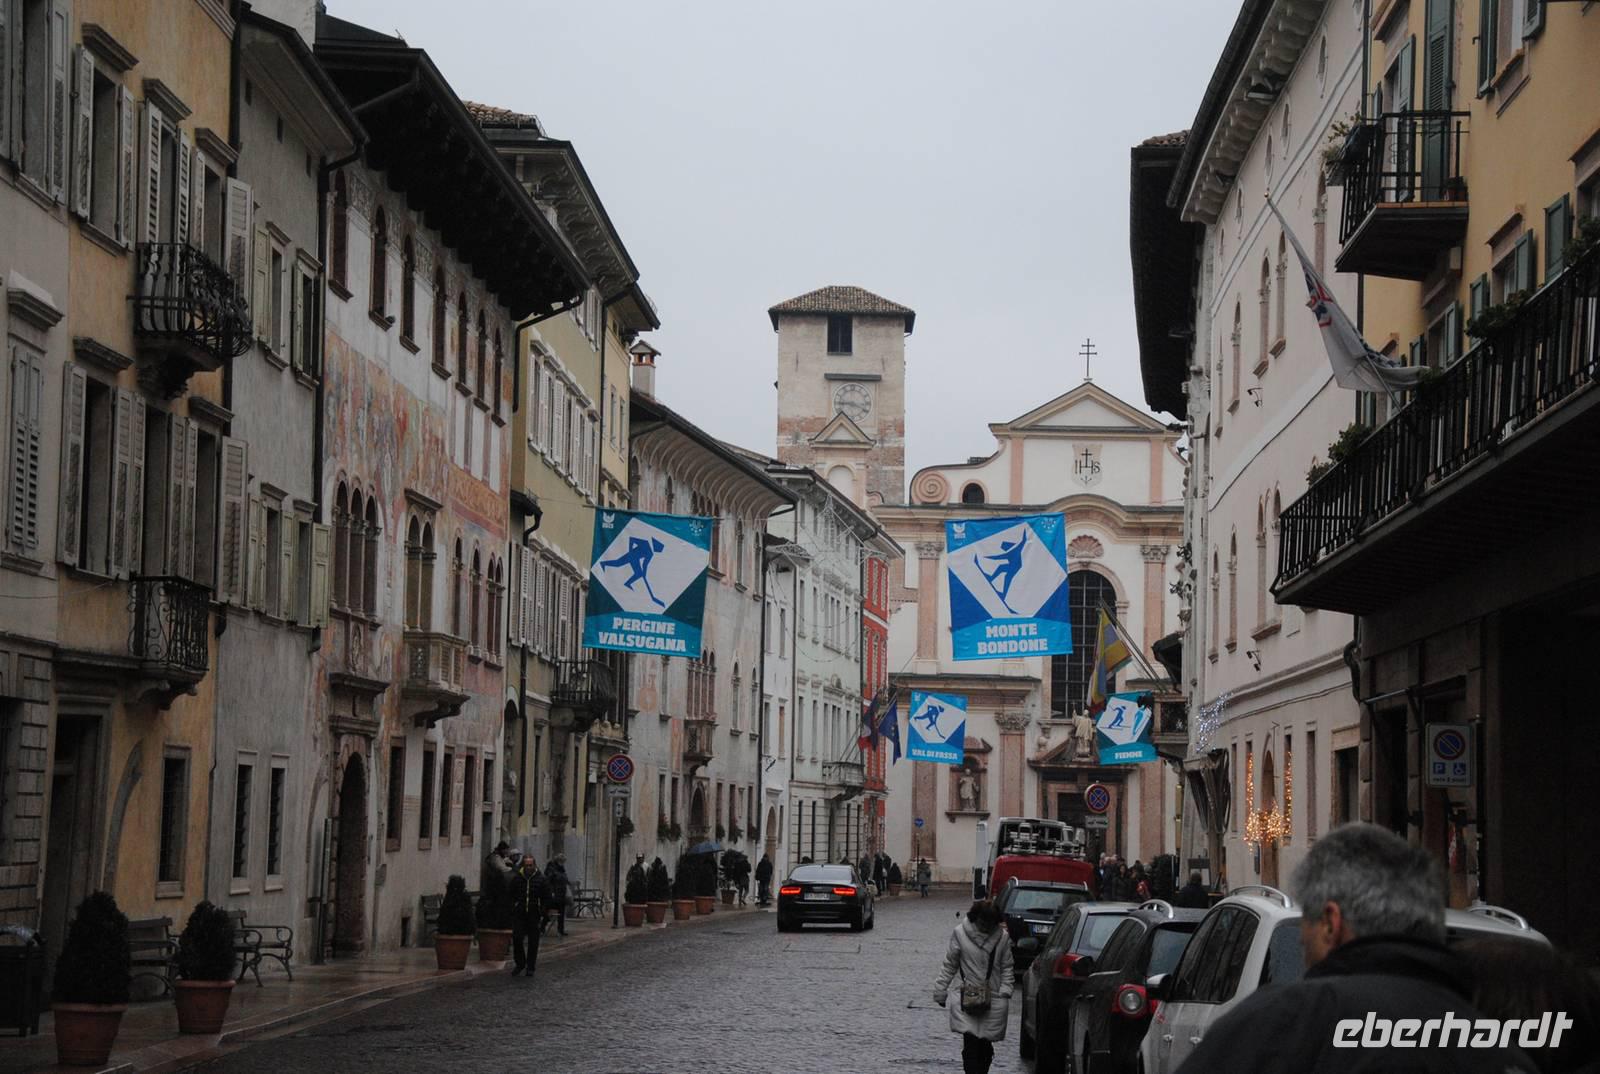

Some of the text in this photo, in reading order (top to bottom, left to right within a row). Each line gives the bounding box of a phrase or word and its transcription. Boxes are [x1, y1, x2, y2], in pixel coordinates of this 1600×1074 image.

[612, 617, 676, 635] PERGINE
[985, 623, 1038, 639] MONTE
[598, 632, 686, 652] VALSUGANA
[977, 638, 1048, 655] BONDONE
[1115, 751, 1143, 760] FIEMME
